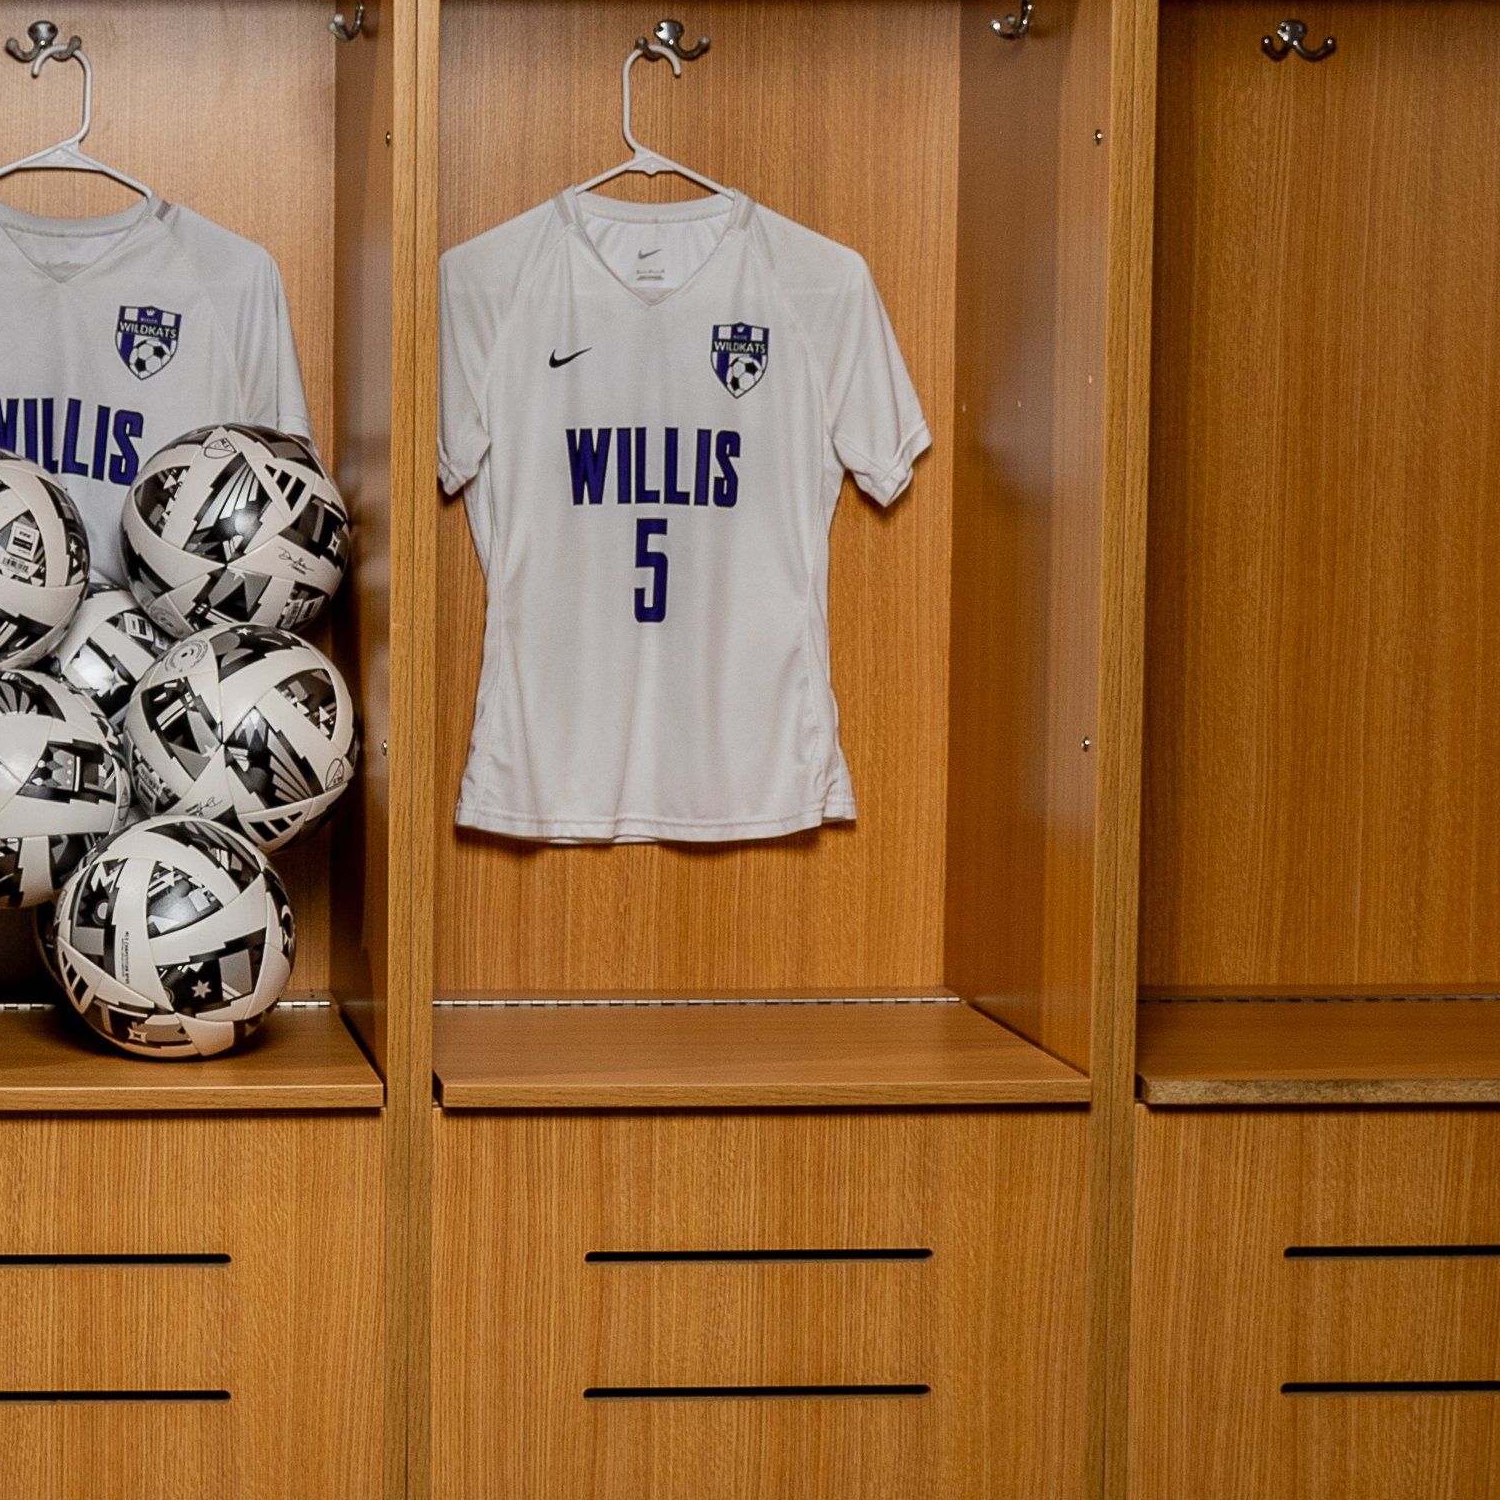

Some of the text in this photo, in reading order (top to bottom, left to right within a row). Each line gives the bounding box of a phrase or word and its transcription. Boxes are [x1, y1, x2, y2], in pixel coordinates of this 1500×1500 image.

[119, 321, 177, 339] WILDKATS
[714, 340, 766, 354] WILDKATS
[565, 426, 741, 508] WILLIS
[634, 518, 669, 623] 5
